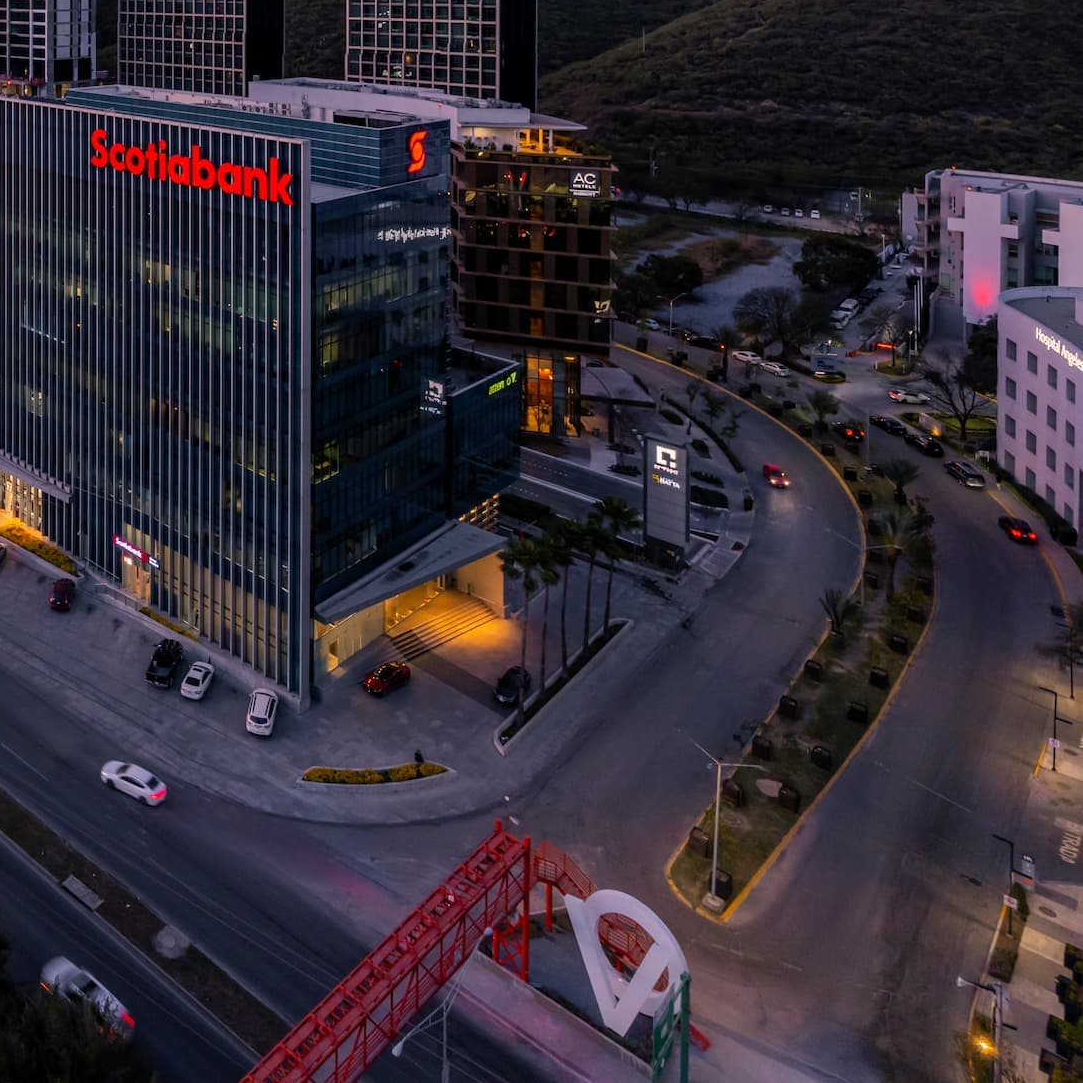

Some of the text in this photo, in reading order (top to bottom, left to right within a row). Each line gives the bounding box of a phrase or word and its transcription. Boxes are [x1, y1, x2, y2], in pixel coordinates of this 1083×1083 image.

[90, 128, 294, 206] Scotiabank
[573, 172, 596, 185] AC
[1036, 327, 1061, 355] Hospital
